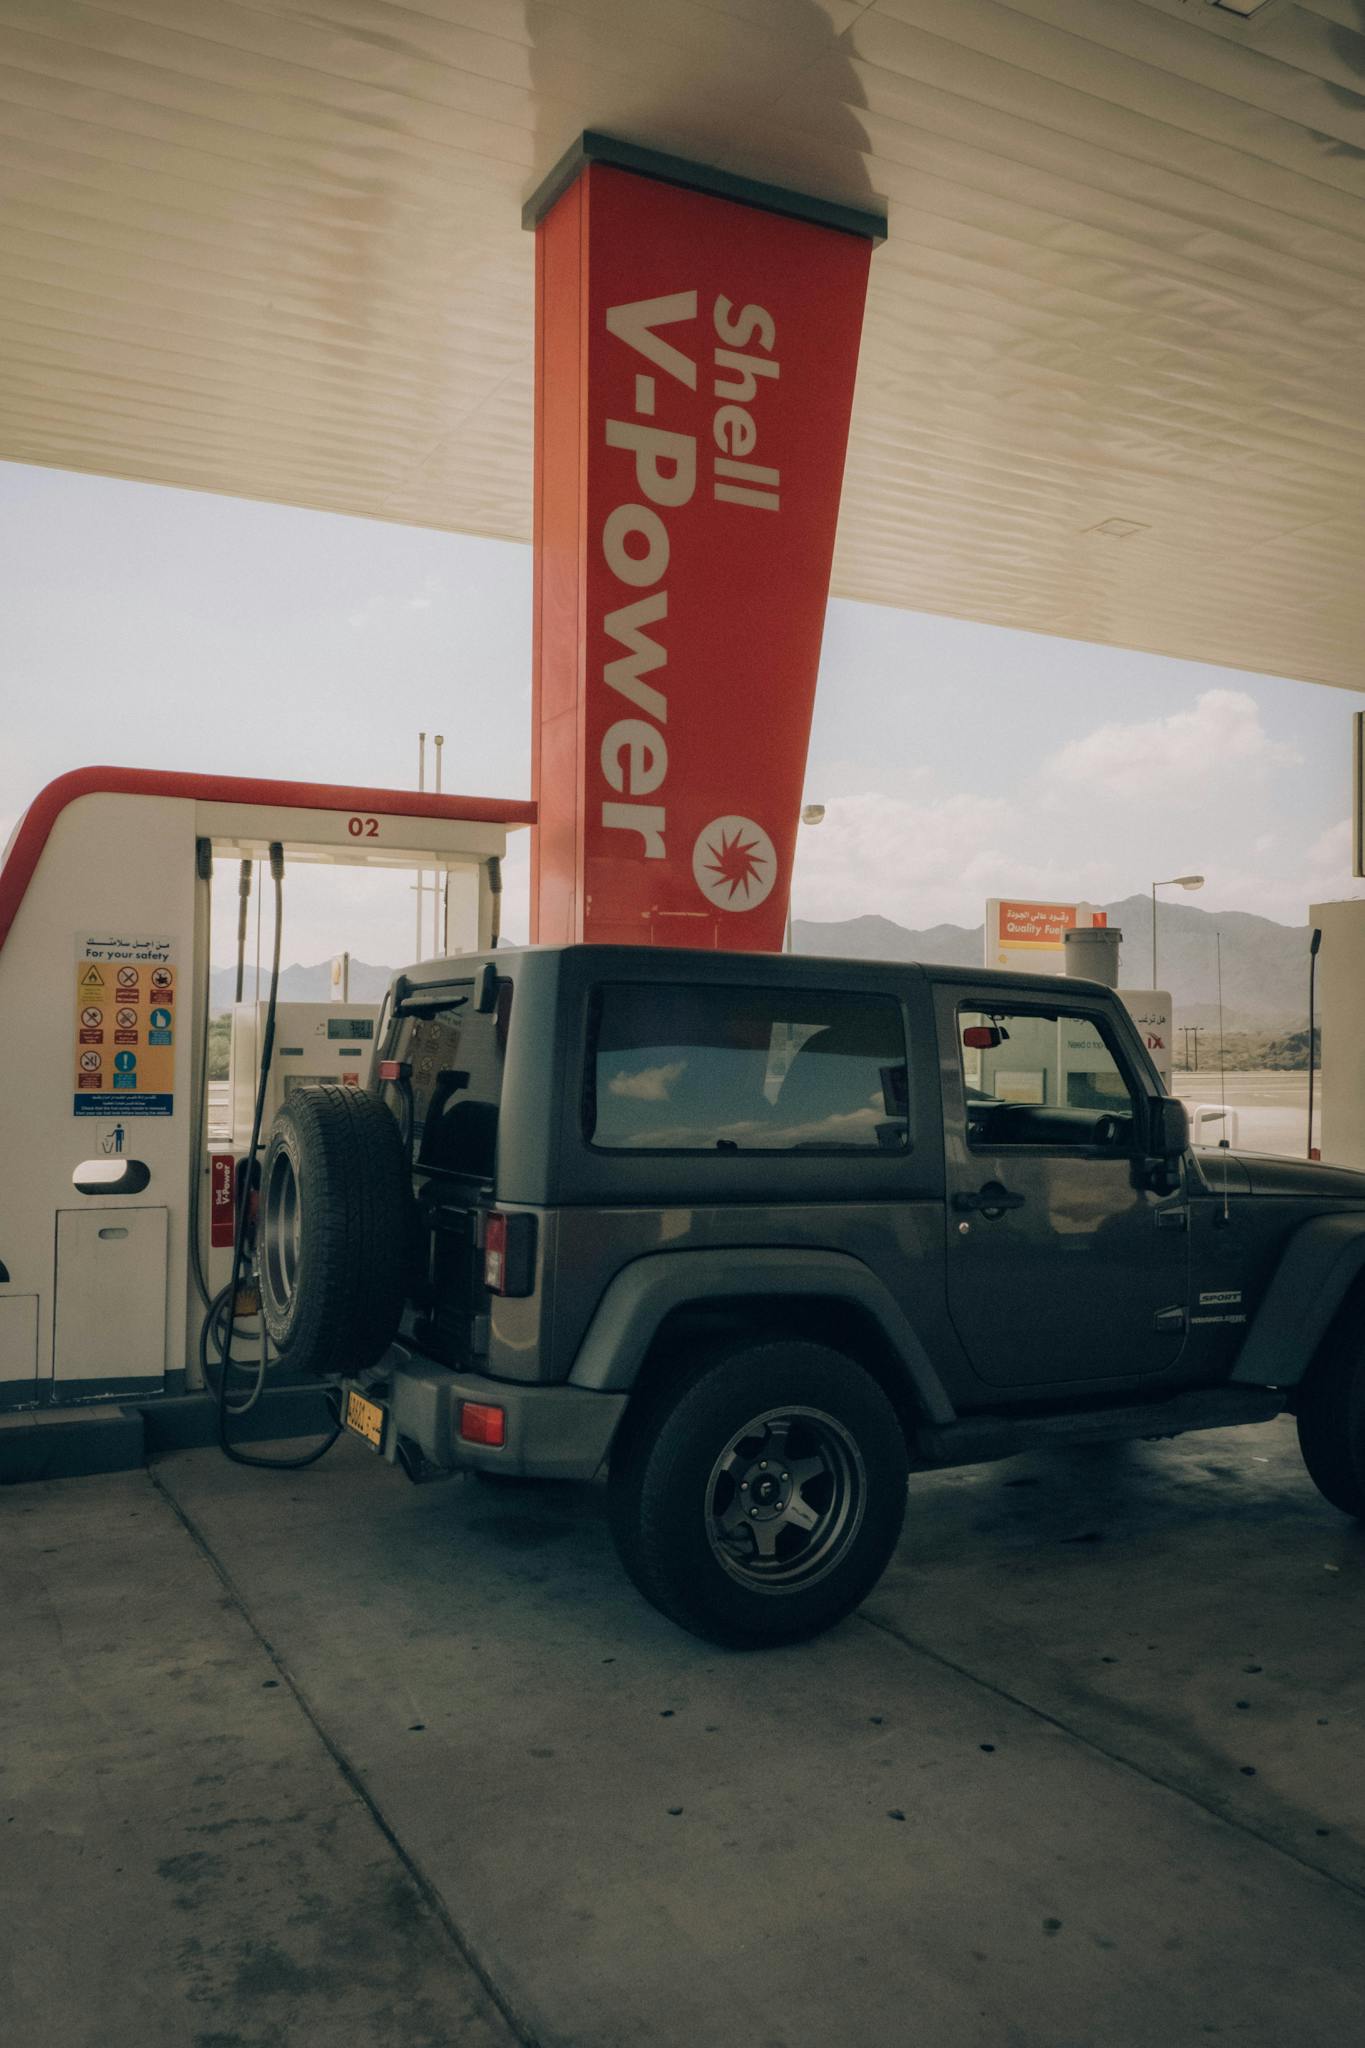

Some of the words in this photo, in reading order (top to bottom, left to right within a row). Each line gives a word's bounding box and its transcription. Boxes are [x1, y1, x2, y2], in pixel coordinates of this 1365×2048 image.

[713, 293, 780, 512] Shell
[601, 289, 698, 860] V-Power
[348, 817, 379, 837] 02
[1007, 922, 1042, 937] Quality
[86, 948, 103, 958] For
[107, 950, 133, 960] your
[136, 950, 169, 962] safety
[1201, 1294, 1239, 1302] SPORT
